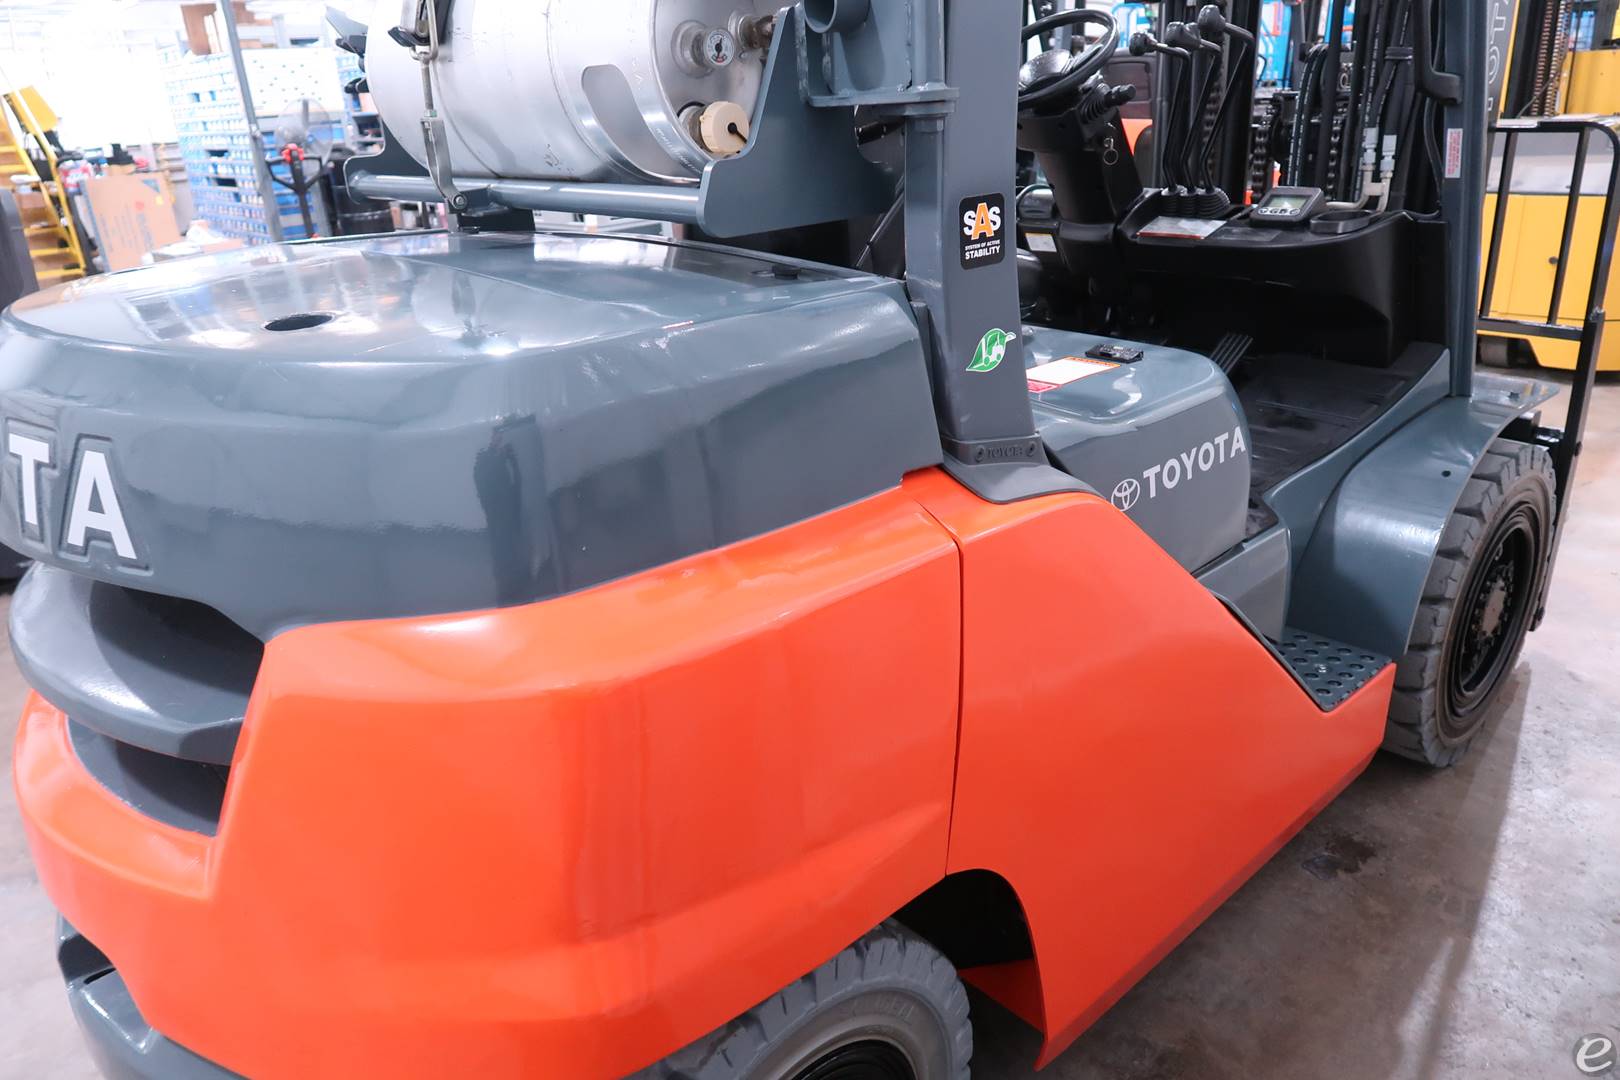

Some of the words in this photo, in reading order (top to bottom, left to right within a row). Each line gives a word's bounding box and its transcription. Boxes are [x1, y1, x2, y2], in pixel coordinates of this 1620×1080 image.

[964, 202, 1001, 240] SAS
[965, 243, 980, 251] SYSTEM
[965, 245, 1000, 260] STABILITY
[1143, 426, 1246, 499] TOYOTA
[9, 433, 137, 560] TA
